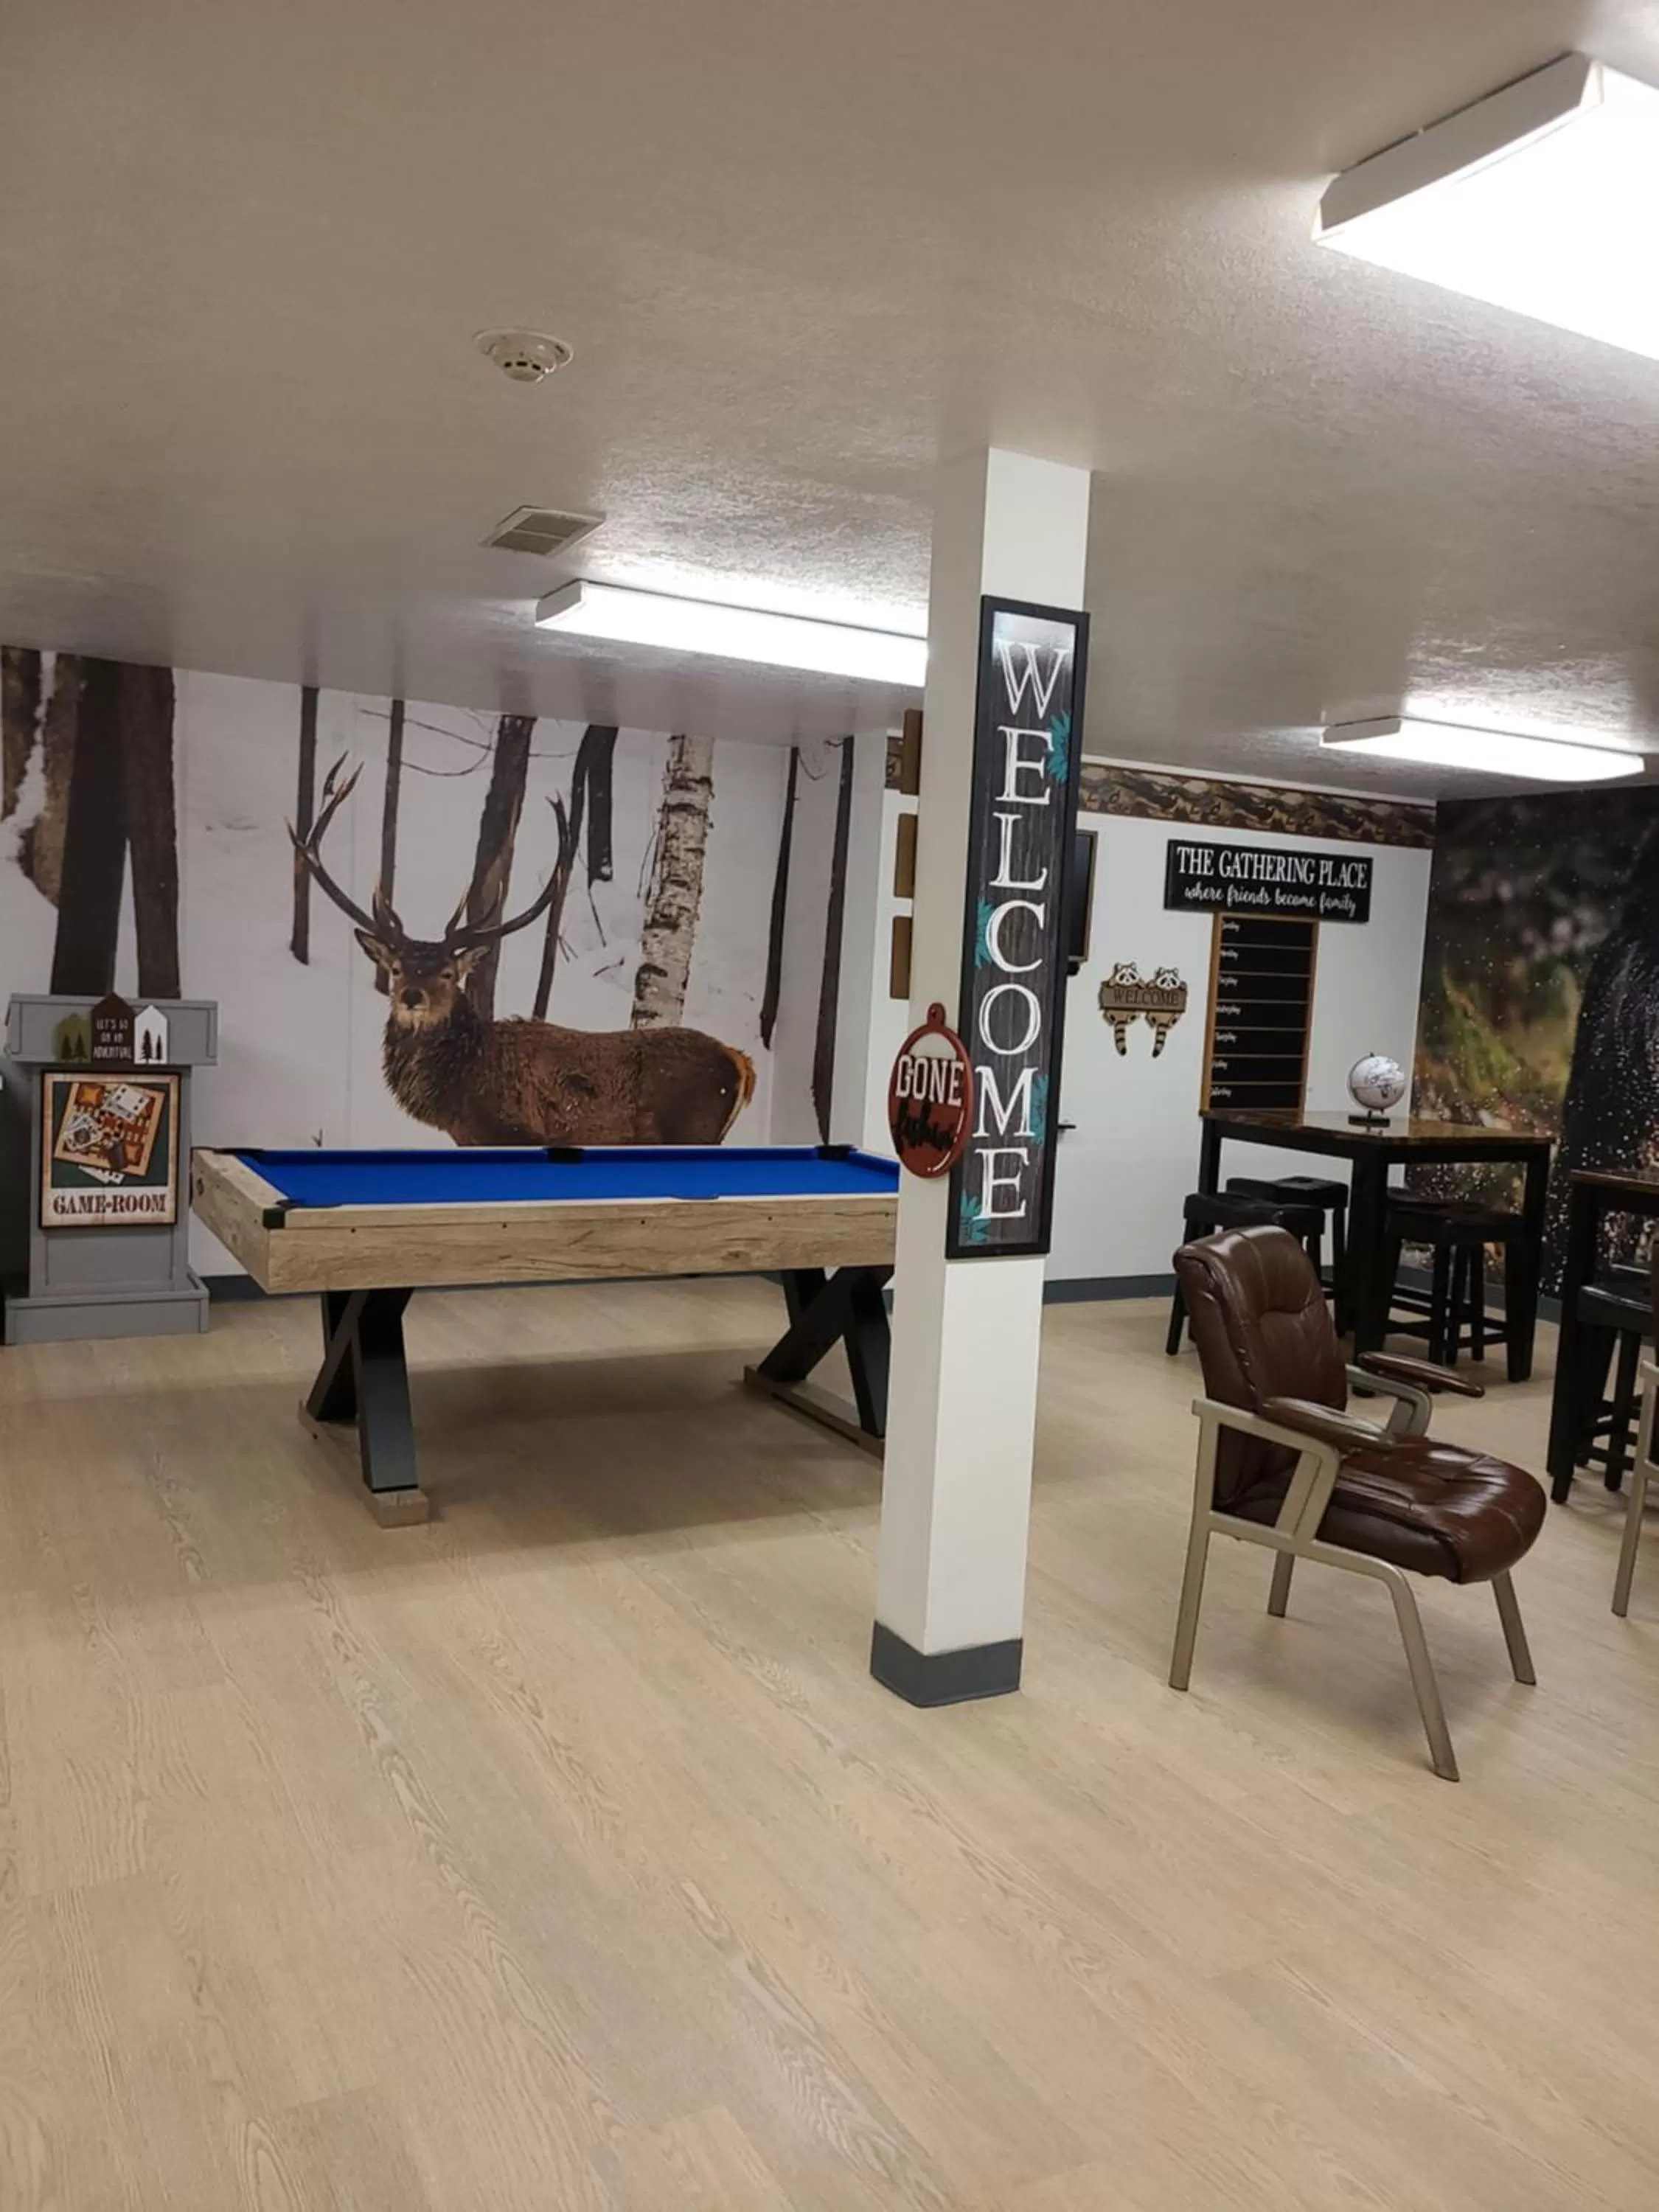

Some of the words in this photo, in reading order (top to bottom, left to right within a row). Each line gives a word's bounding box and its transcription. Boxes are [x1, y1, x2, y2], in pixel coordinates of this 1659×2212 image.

[1177, 846, 1214, 877] THE
[1219, 850, 1315, 884] GATHERING
[1318, 860, 1367, 889] PLACE
[1185, 881, 1223, 902] where
[1227, 884, 1271, 908] friends
[1275, 887, 1316, 908] become
[1319, 891, 1357, 917] family
[972, 640, 1071, 1220] WELCOME
[1113, 987, 1180, 1006] WELCOME
[894, 1054, 965, 1107] GONE
